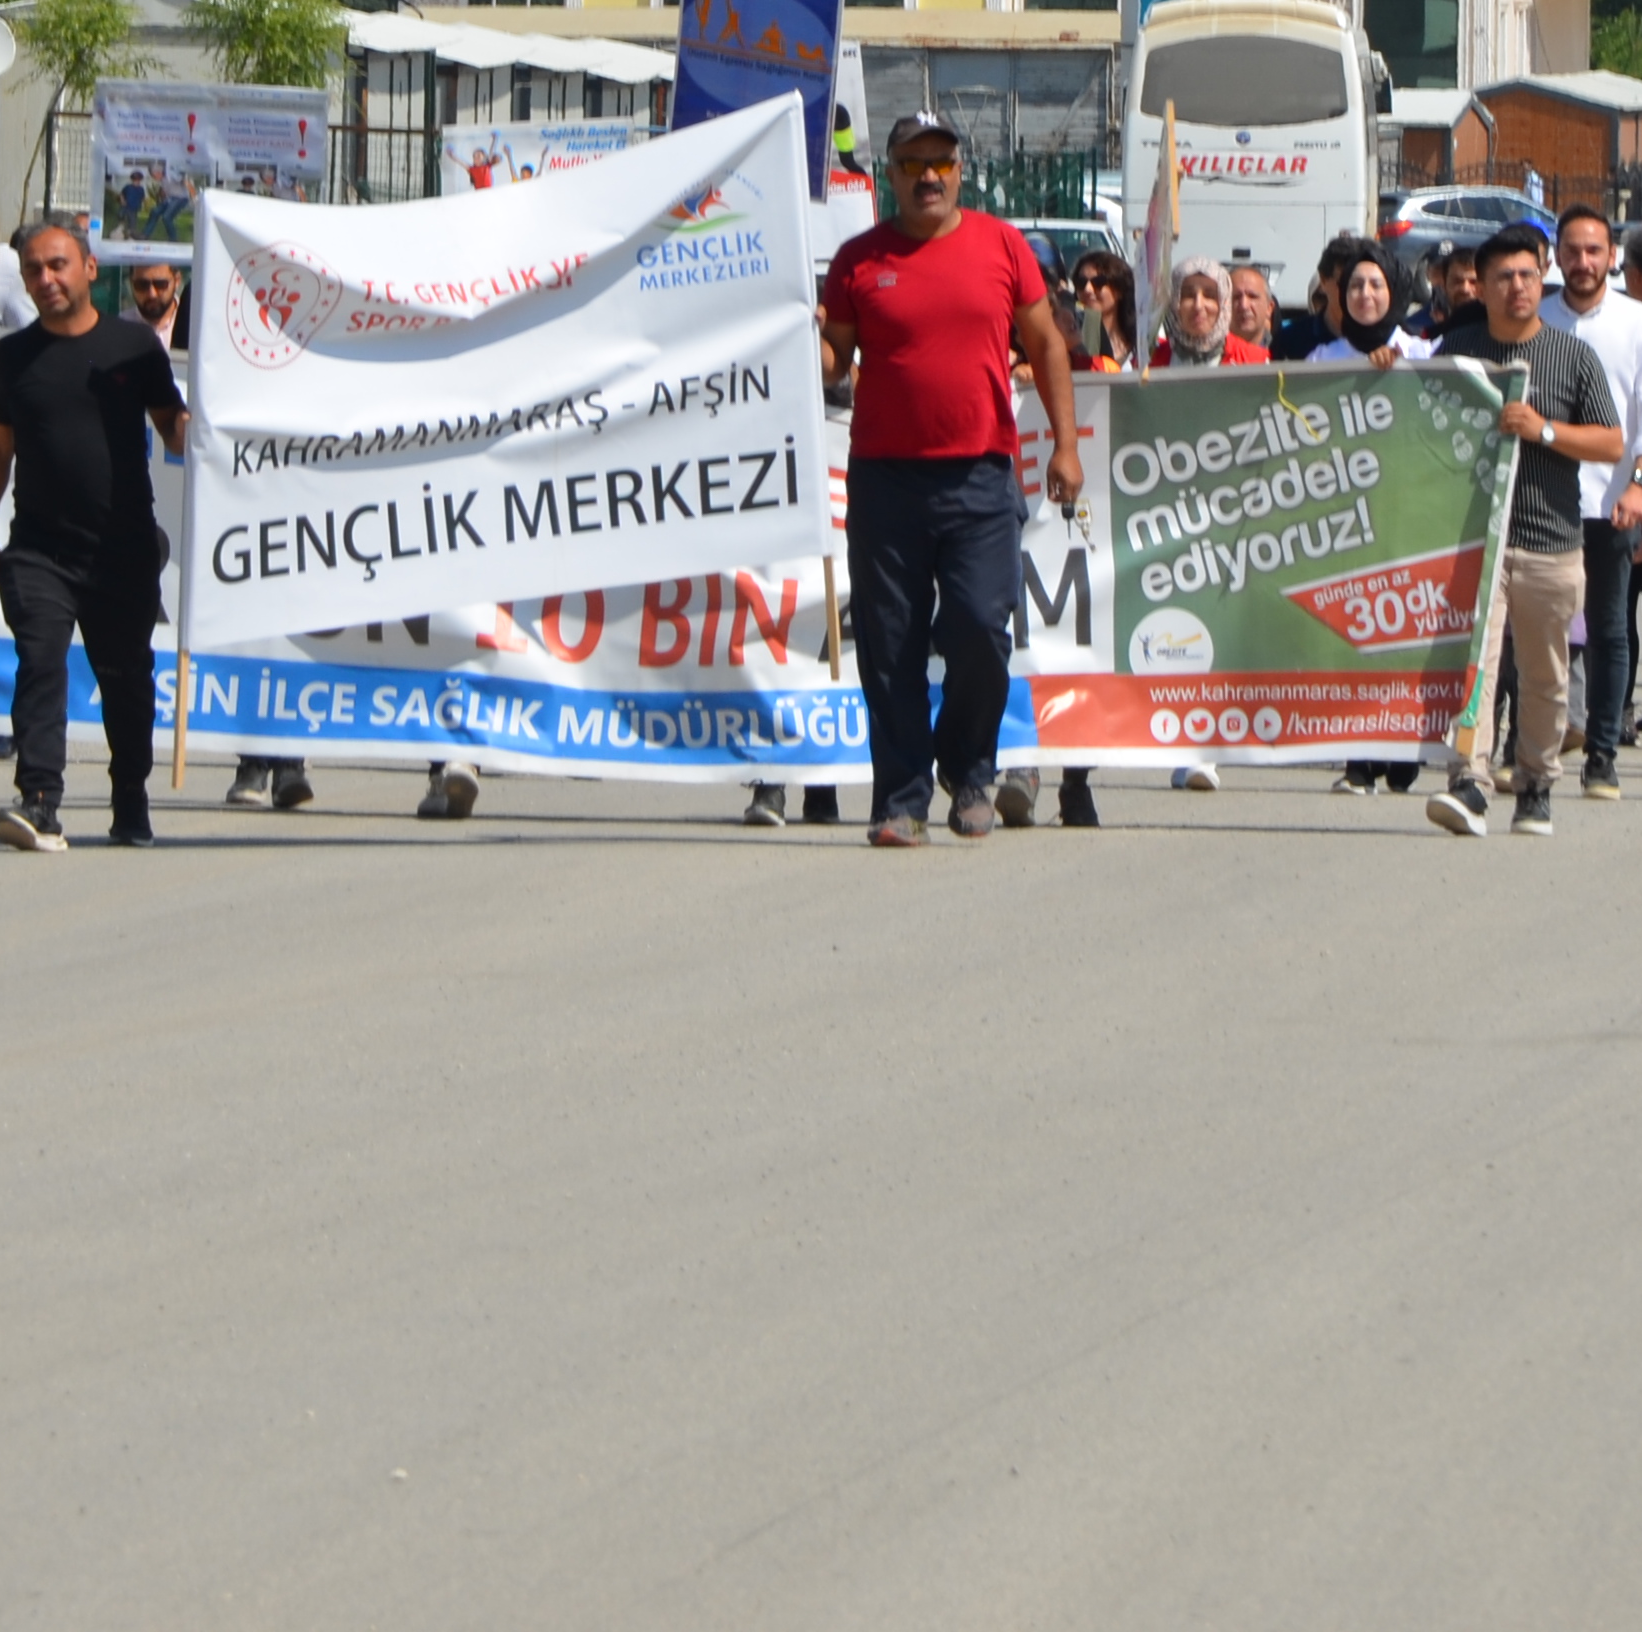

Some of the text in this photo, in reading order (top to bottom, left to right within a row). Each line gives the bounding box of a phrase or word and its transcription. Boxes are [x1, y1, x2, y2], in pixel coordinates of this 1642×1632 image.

[635, 230, 767, 269] GENÇLİK
[639, 256, 770, 292] MERKEZLERİ
[361, 279, 410, 305] T.C.
[414, 264, 542, 308] GENÇLİK
[345, 310, 425, 334] SPOR
[232, 388, 609, 478] KAHRAMANMARAŞ
[648, 362, 771, 419] AFŞİN
[1112, 402, 1332, 497] Obezite
[1339, 393, 1394, 438] ile
[212, 482, 487, 585] GENÇLİK
[503, 433, 799, 544] MERKEZİ
[1125, 446, 1381, 553] mücadele
[1140, 496, 1376, 603] ediyoruz!
[1313, 570, 1412, 610] günde en az
[1343, 590, 1406, 641] 30
[257, 667, 357, 733] İLÇE
[369, 677, 544, 741] SAĞLIK
[557, 694, 868, 750] MÜDÜRLÜĞÜ
